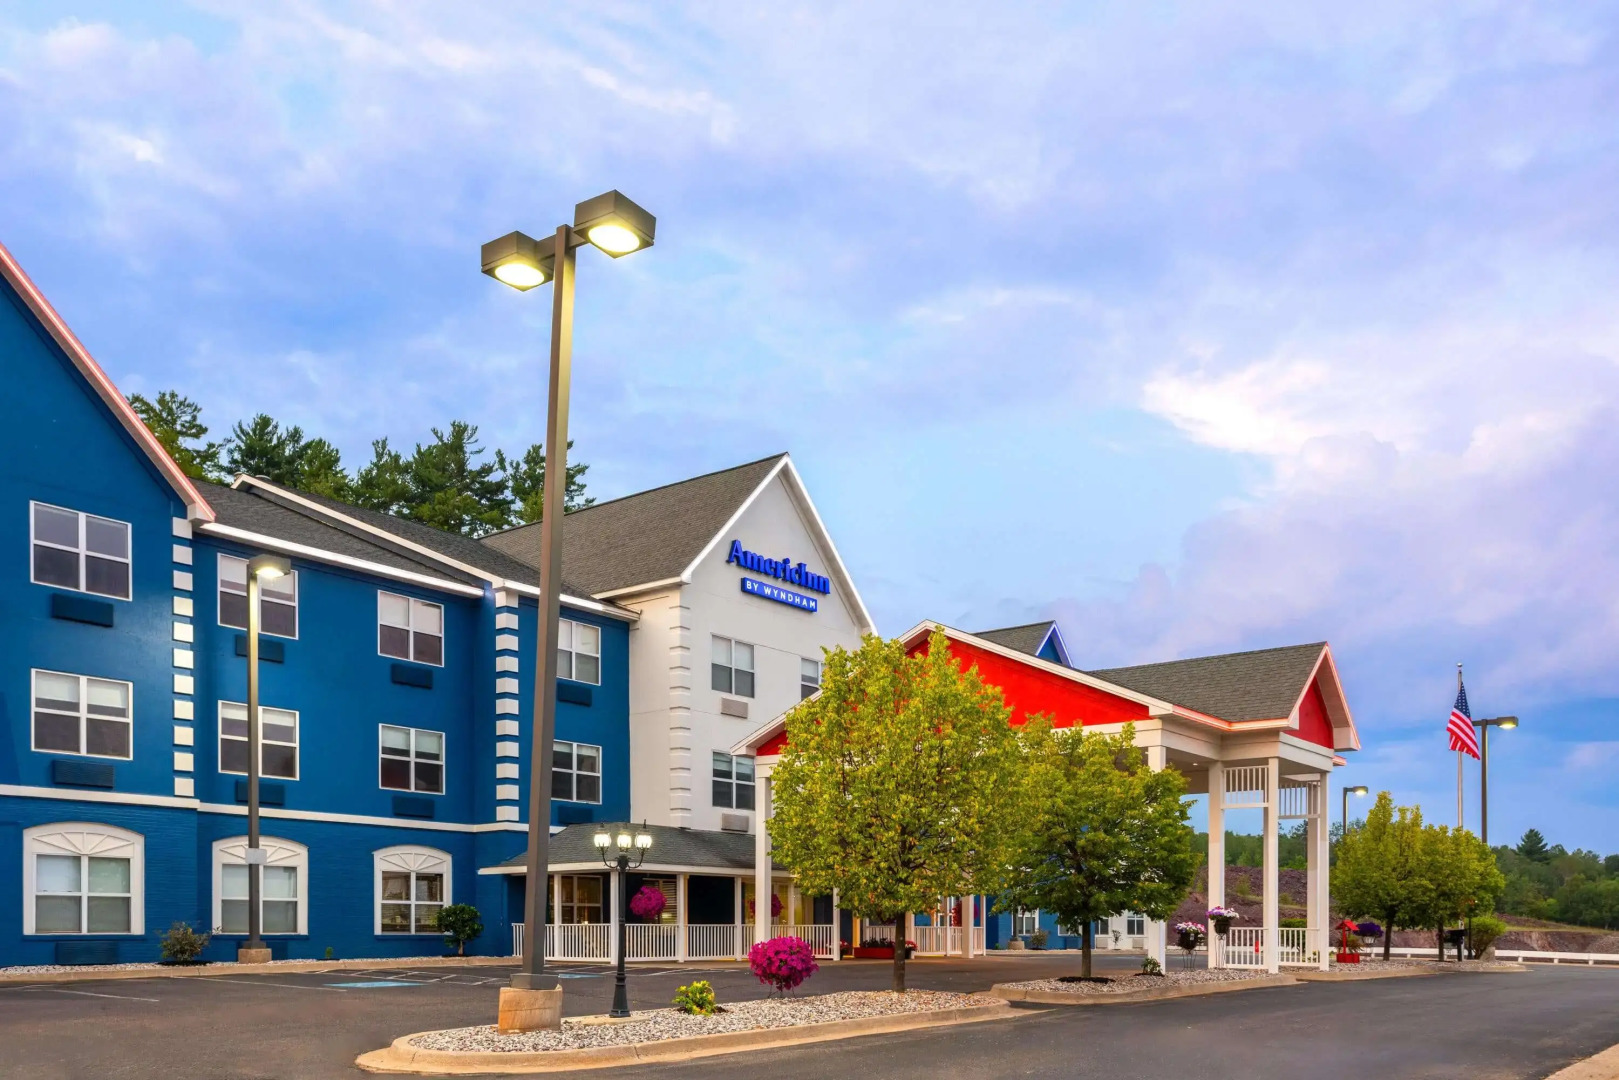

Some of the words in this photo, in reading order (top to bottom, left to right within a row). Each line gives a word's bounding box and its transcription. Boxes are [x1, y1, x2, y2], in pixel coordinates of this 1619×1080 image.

[726, 539, 830, 595] AmericInn
[746, 581, 759, 592] BY
[763, 586, 816, 609] WYNDHAM
